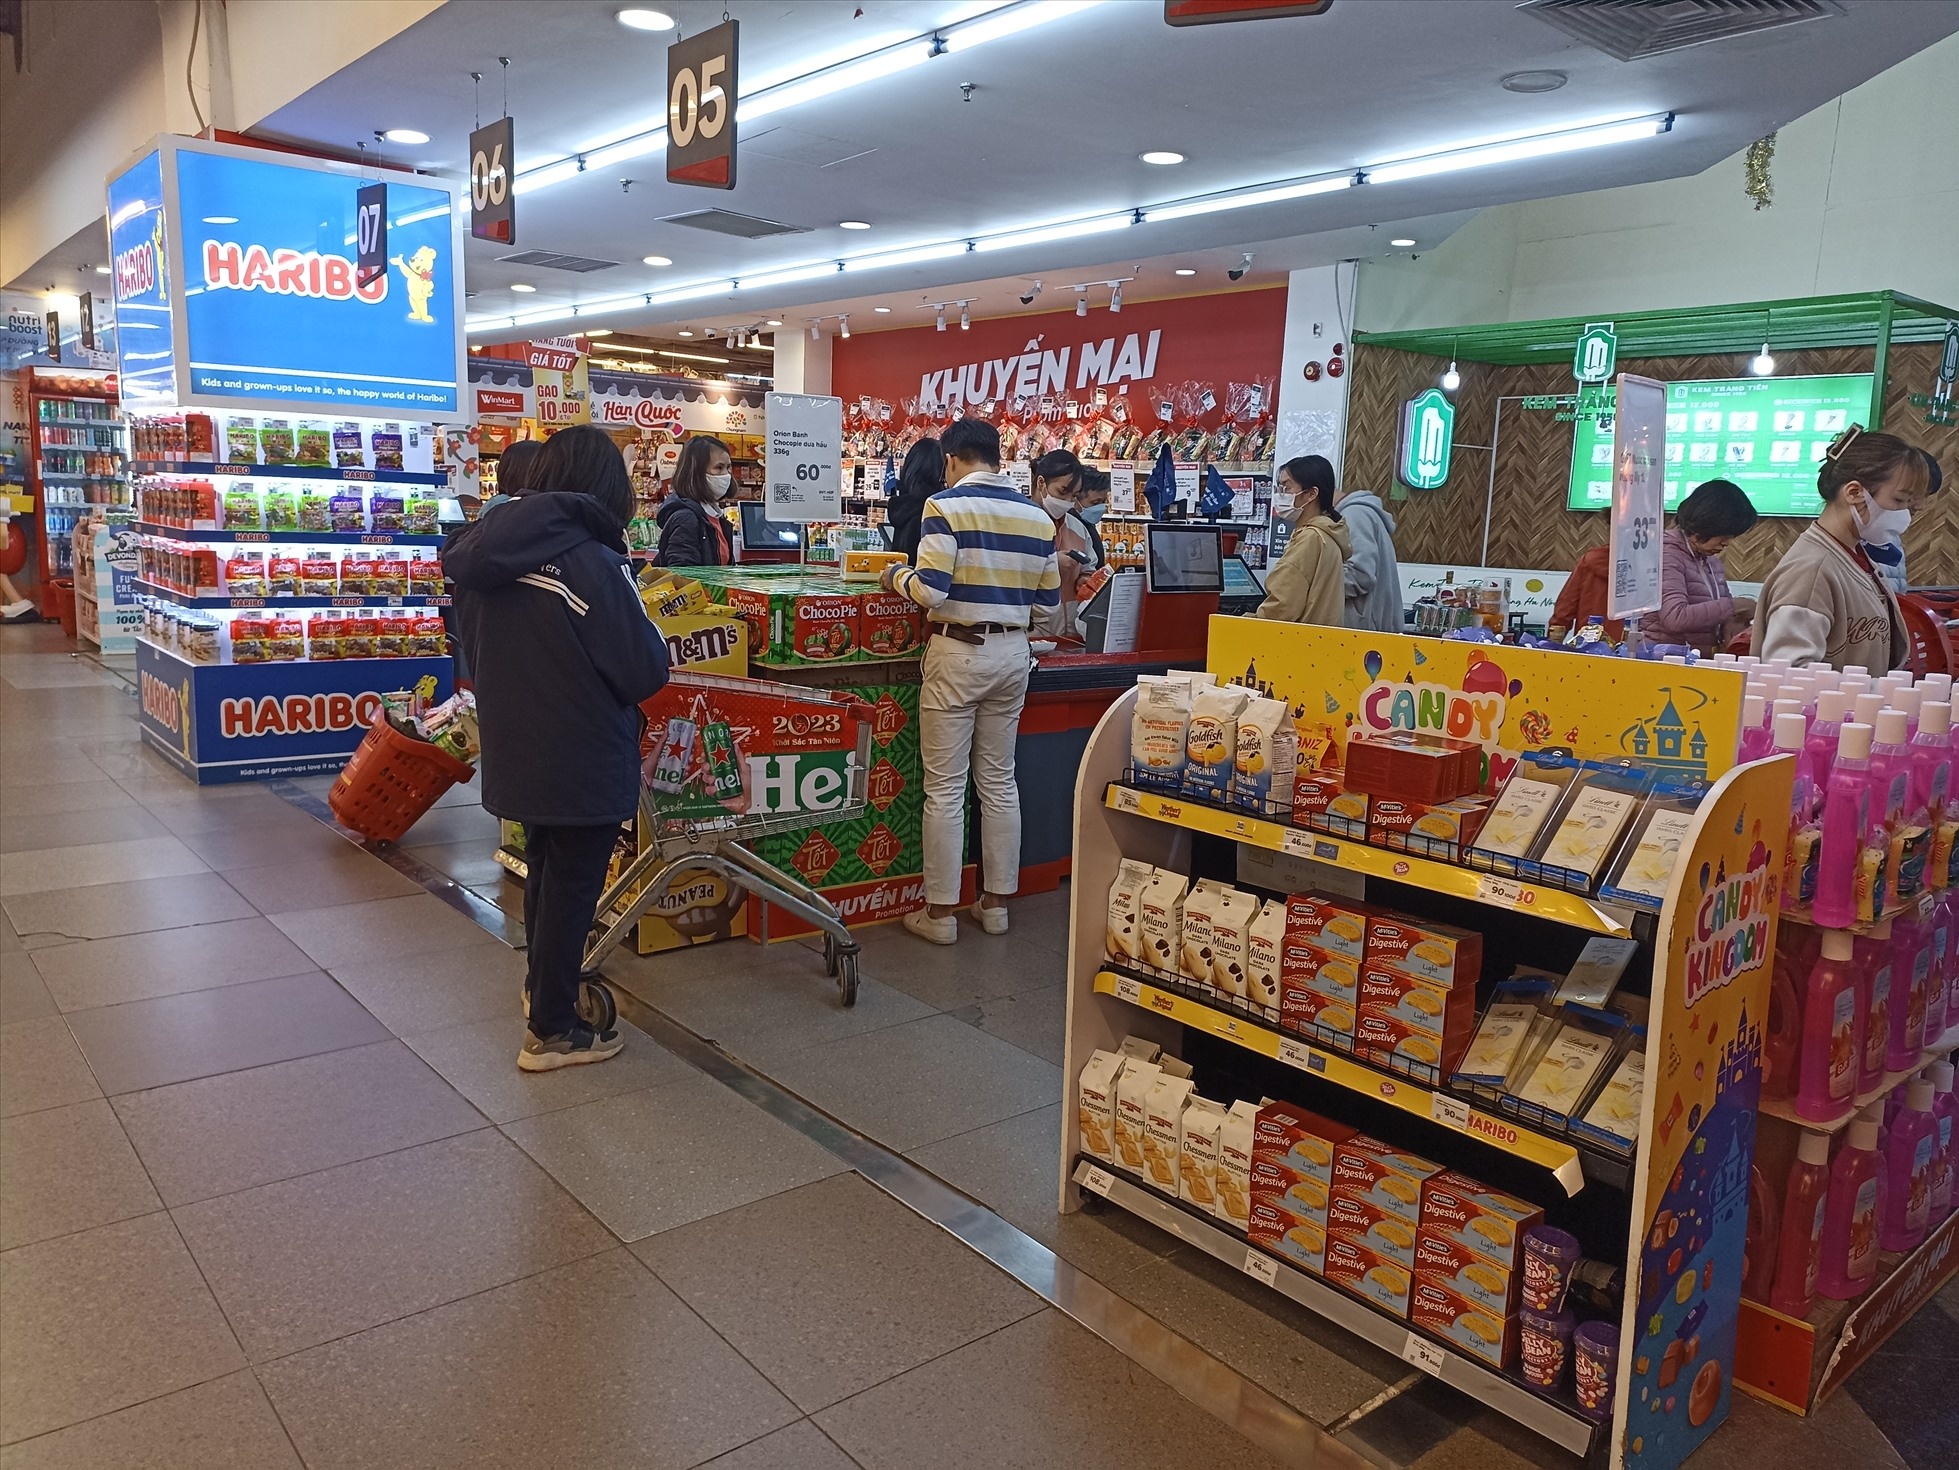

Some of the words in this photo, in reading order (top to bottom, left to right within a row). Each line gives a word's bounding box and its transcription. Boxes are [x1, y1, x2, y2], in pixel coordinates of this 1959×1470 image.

[670, 54, 727, 148] 05
[471, 143, 507, 211] 06
[358, 203, 381, 256] 07
[9, 315, 41, 325] nutri
[9, 324, 42, 335] boost
[530, 350, 551, 367] GIÁ
[553, 352, 573, 370] TỐT
[918, 333, 1071, 414] KHUYẾN
[1076, 329, 1162, 394] MẠI
[201, 378, 222, 388] Kids
[223, 379, 242, 389] and
[244, 381, 293, 394] grown-ups
[294, 384, 313, 394] love
[314, 385, 321, 394] it
[322, 387, 335, 397] so,
[337, 387, 351, 397] the
[353, 388, 380, 400] happy
[381, 390, 405, 400] world
[406, 391, 416, 400] of
[417, 392, 447, 403] Haribo!
[480, 393, 516, 405] WinMart
[1522, 396, 1557, 410] KEM
[603, 401, 633, 421] Hàn
[634, 400, 683, 427] Quốc
[1555, 412, 1592, 422] SINCE
[1595, 412, 1616, 422] 195
[773, 439, 802, 447] Chocopie
[773, 448, 790, 456] 336g
[215, 465, 250, 475] HARIBO
[343, 470, 375, 481] HARIBO
[796, 464, 820, 481] 60
[235, 533, 270, 542] HARIBO
[361, 535, 393, 544] HARIBO
[1633, 517, 1649, 550] 33
[231, 598, 265, 608] HARIBO
[332, 597, 364, 607] HARIBO
[728, 597, 767, 617] ChocoPie
[865, 601, 918, 617] ChocoPie
[800, 605, 858, 620] ChocoPie
[116, 615, 145, 625] 100%
[141, 669, 178, 733] HARIBO
[222, 693, 382, 737] HARIBO
[875, 705, 898, 732] Tết
[1365, 686, 1499, 740] CANDY
[772, 713, 841, 735] 2023
[772, 737, 790, 747] Khởi
[791, 737, 806, 746] Sắc
[808, 737, 823, 745] Tân
[823, 736, 841, 745] Niên
[1188, 729, 1223, 745] Goldfish
[240, 768, 255, 776] Kids
[256, 766, 270, 775] and
[271, 764, 307, 774] grown-ups
[307, 762, 321, 771] love
[328, 762, 337, 770] so,
[1187, 762, 1219, 776] ORIGINAL
[870, 769, 895, 796] Tết
[1294, 795, 1328, 806] Digestive
[1372, 814, 1413, 826] Digestive
[867, 833, 892, 860] Tết
[803, 842, 829, 870] Tết
[656, 883, 716, 910] PEANUT
[834, 881, 898, 919] HUYẾN
[875, 904, 915, 919] Promotion
[1697, 872, 1764, 943] CANDY
[1141, 912, 1169, 929] Milano
[1287, 915, 1323, 926] Digestive
[1144, 928, 1164, 937] CHOCOLATE
[1186, 935, 1209, 945] CHOCOLATE
[1212, 935, 1241, 953] Milano
[1334, 939, 1349, 948] Light
[1369, 937, 1409, 949] Digestive
[1214, 951, 1236, 960] CHOCOLATE
[1687, 920, 1768, 1000] KINGDOM
[1283, 958, 1318, 970] Digestive
[1422, 964, 1438, 974] Light
[1329, 984, 1343, 993] Light
[1362, 984, 1401, 997] Digestive
[1283, 1001, 1316, 1013] Digestive
[1413, 1012, 1429, 1022] Light
[1358, 1029, 1397, 1044] Digestive
[1080, 1097, 1110, 1115] Chessmen
[1117, 1108, 1145, 1128] Chessmen
[1145, 1124, 1177, 1144] Chessmen
[1255, 1132, 1291, 1146] Digestive
[1183, 1141, 1217, 1161] Chessmen
[1302, 1161, 1317, 1171] Light
[1252, 1173, 1287, 1188] Digestive
[1335, 1166, 1375, 1182] Digestive
[1299, 1204, 1314, 1214] Light
[1388, 1198, 1404, 1210] Light
[1250, 1216, 1285, 1232] Digestive
[1297, 1247, 1311, 1258] Light
[1383, 1241, 1399, 1254] Light
[1525, 1344, 1551, 1355] BEAN
